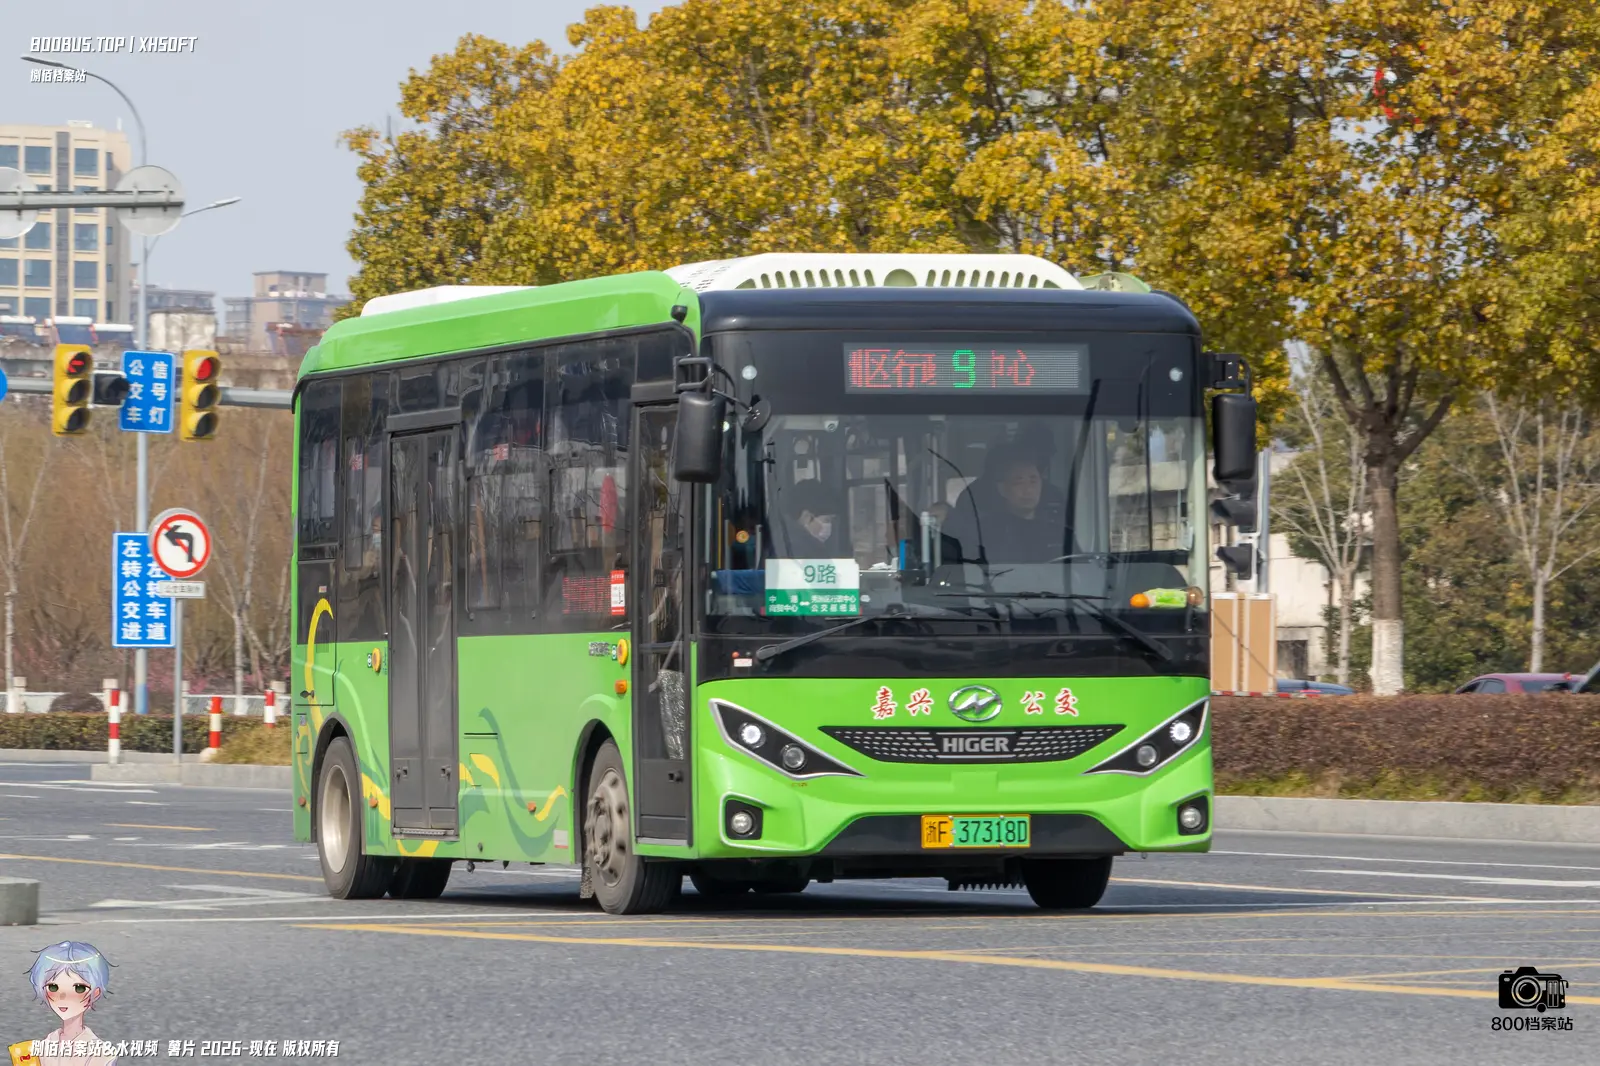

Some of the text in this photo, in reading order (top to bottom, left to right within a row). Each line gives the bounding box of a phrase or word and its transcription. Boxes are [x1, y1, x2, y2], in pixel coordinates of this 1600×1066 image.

[952, 349, 976, 388] 9
[149, 361, 168, 425] 信号灯
[121, 539, 142, 640] 左转公交进
[804, 564, 836, 584] 9路
[146, 552, 167, 640] 左转车道
[871, 686, 1079, 719] 嘉兴 公交
[942, 737, 1009, 753] HIGER
[958, 820, 1028, 843] 37318D
